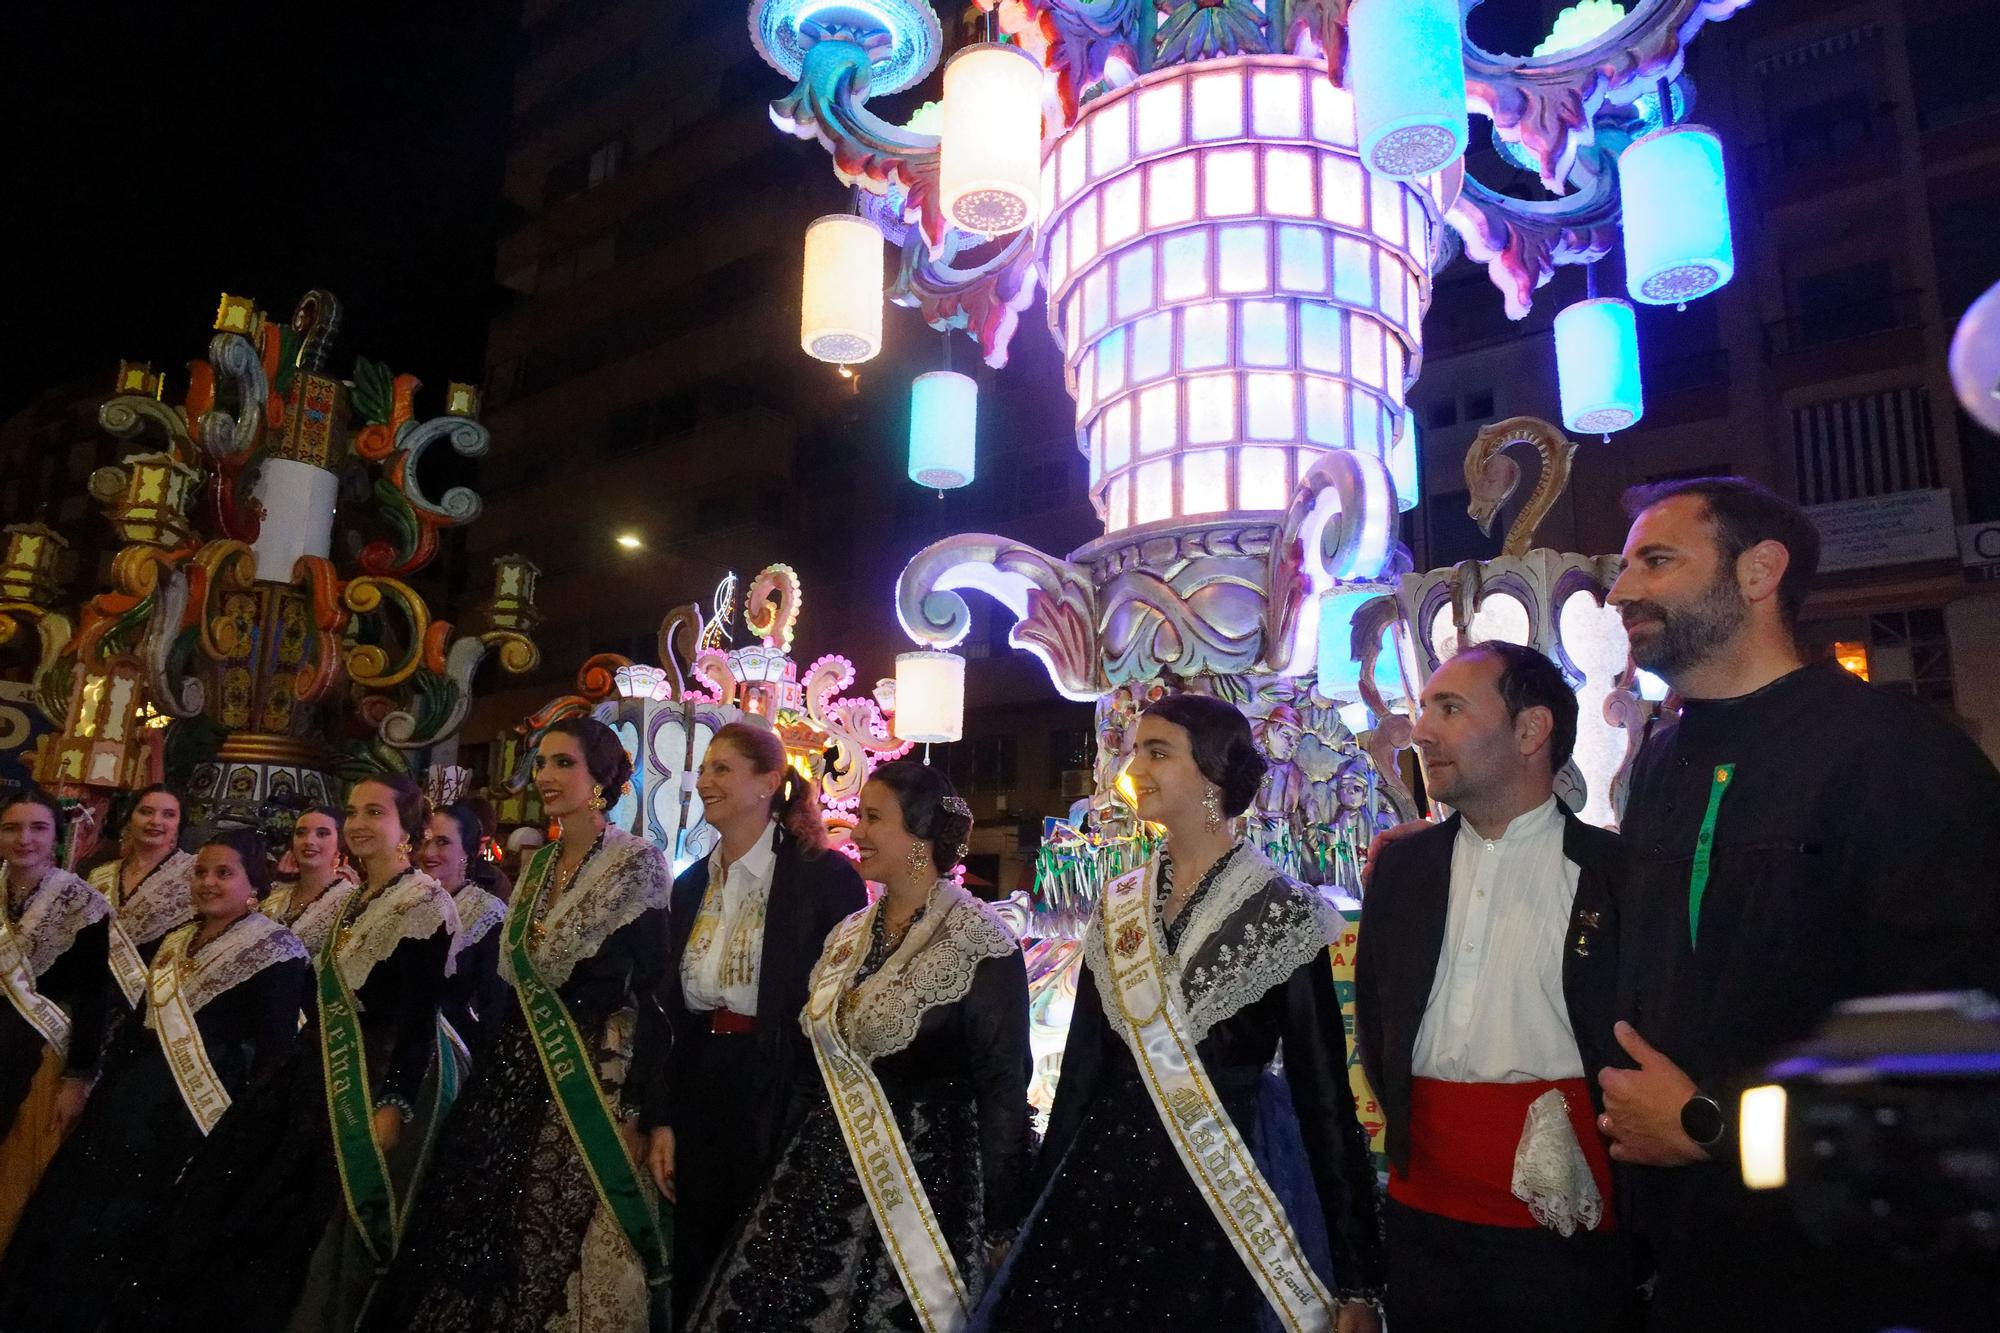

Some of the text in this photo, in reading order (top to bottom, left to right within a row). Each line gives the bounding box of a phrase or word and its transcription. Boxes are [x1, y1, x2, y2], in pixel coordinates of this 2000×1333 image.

[326, 1001, 352, 1095] Reina
[525, 978, 576, 1082] Reina
[829, 1054, 904, 1211] Madrina
[1167, 1087, 1316, 1306] Madrina Infantil
